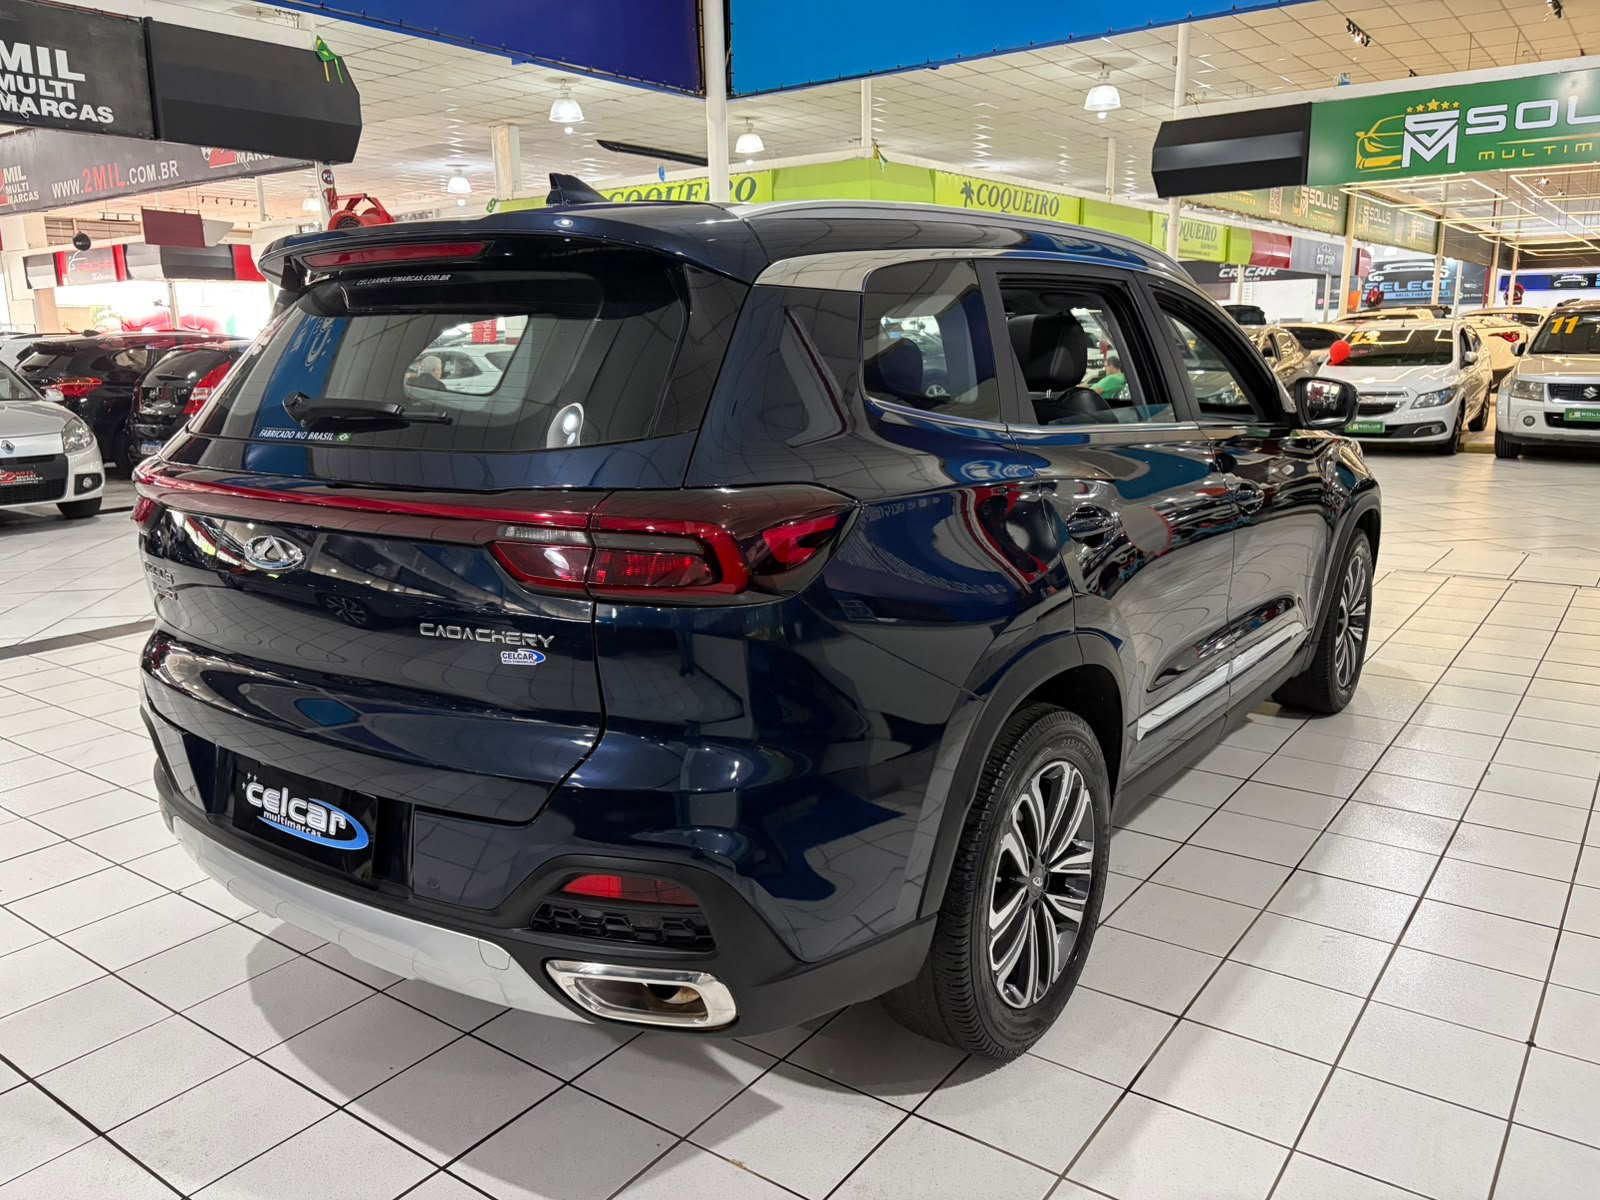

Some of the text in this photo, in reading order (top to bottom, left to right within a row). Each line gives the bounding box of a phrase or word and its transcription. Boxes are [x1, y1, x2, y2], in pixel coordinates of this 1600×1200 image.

[0, 93, 115, 124] MARCAS
[3, 166, 27, 184] MIL
[5, 183, 30, 195] MULTI
[7, 191, 39, 204] MARCAS
[976, 184, 1060, 217] COQUEIRO
[1309, 188, 1340, 211] SOLUS
[1245, 267, 1278, 277] CAR
[1363, 279, 1452, 294] SELECT
[1551, 316, 1579, 334] 11
[1351, 330, 1381, 345] 13
[259, 428, 335, 441] FABRICADO NO BRASIL
[502, 651, 535, 661] CELCAR
[246, 781, 347, 835] celcar
[263, 811, 322, 838] multimarcas
